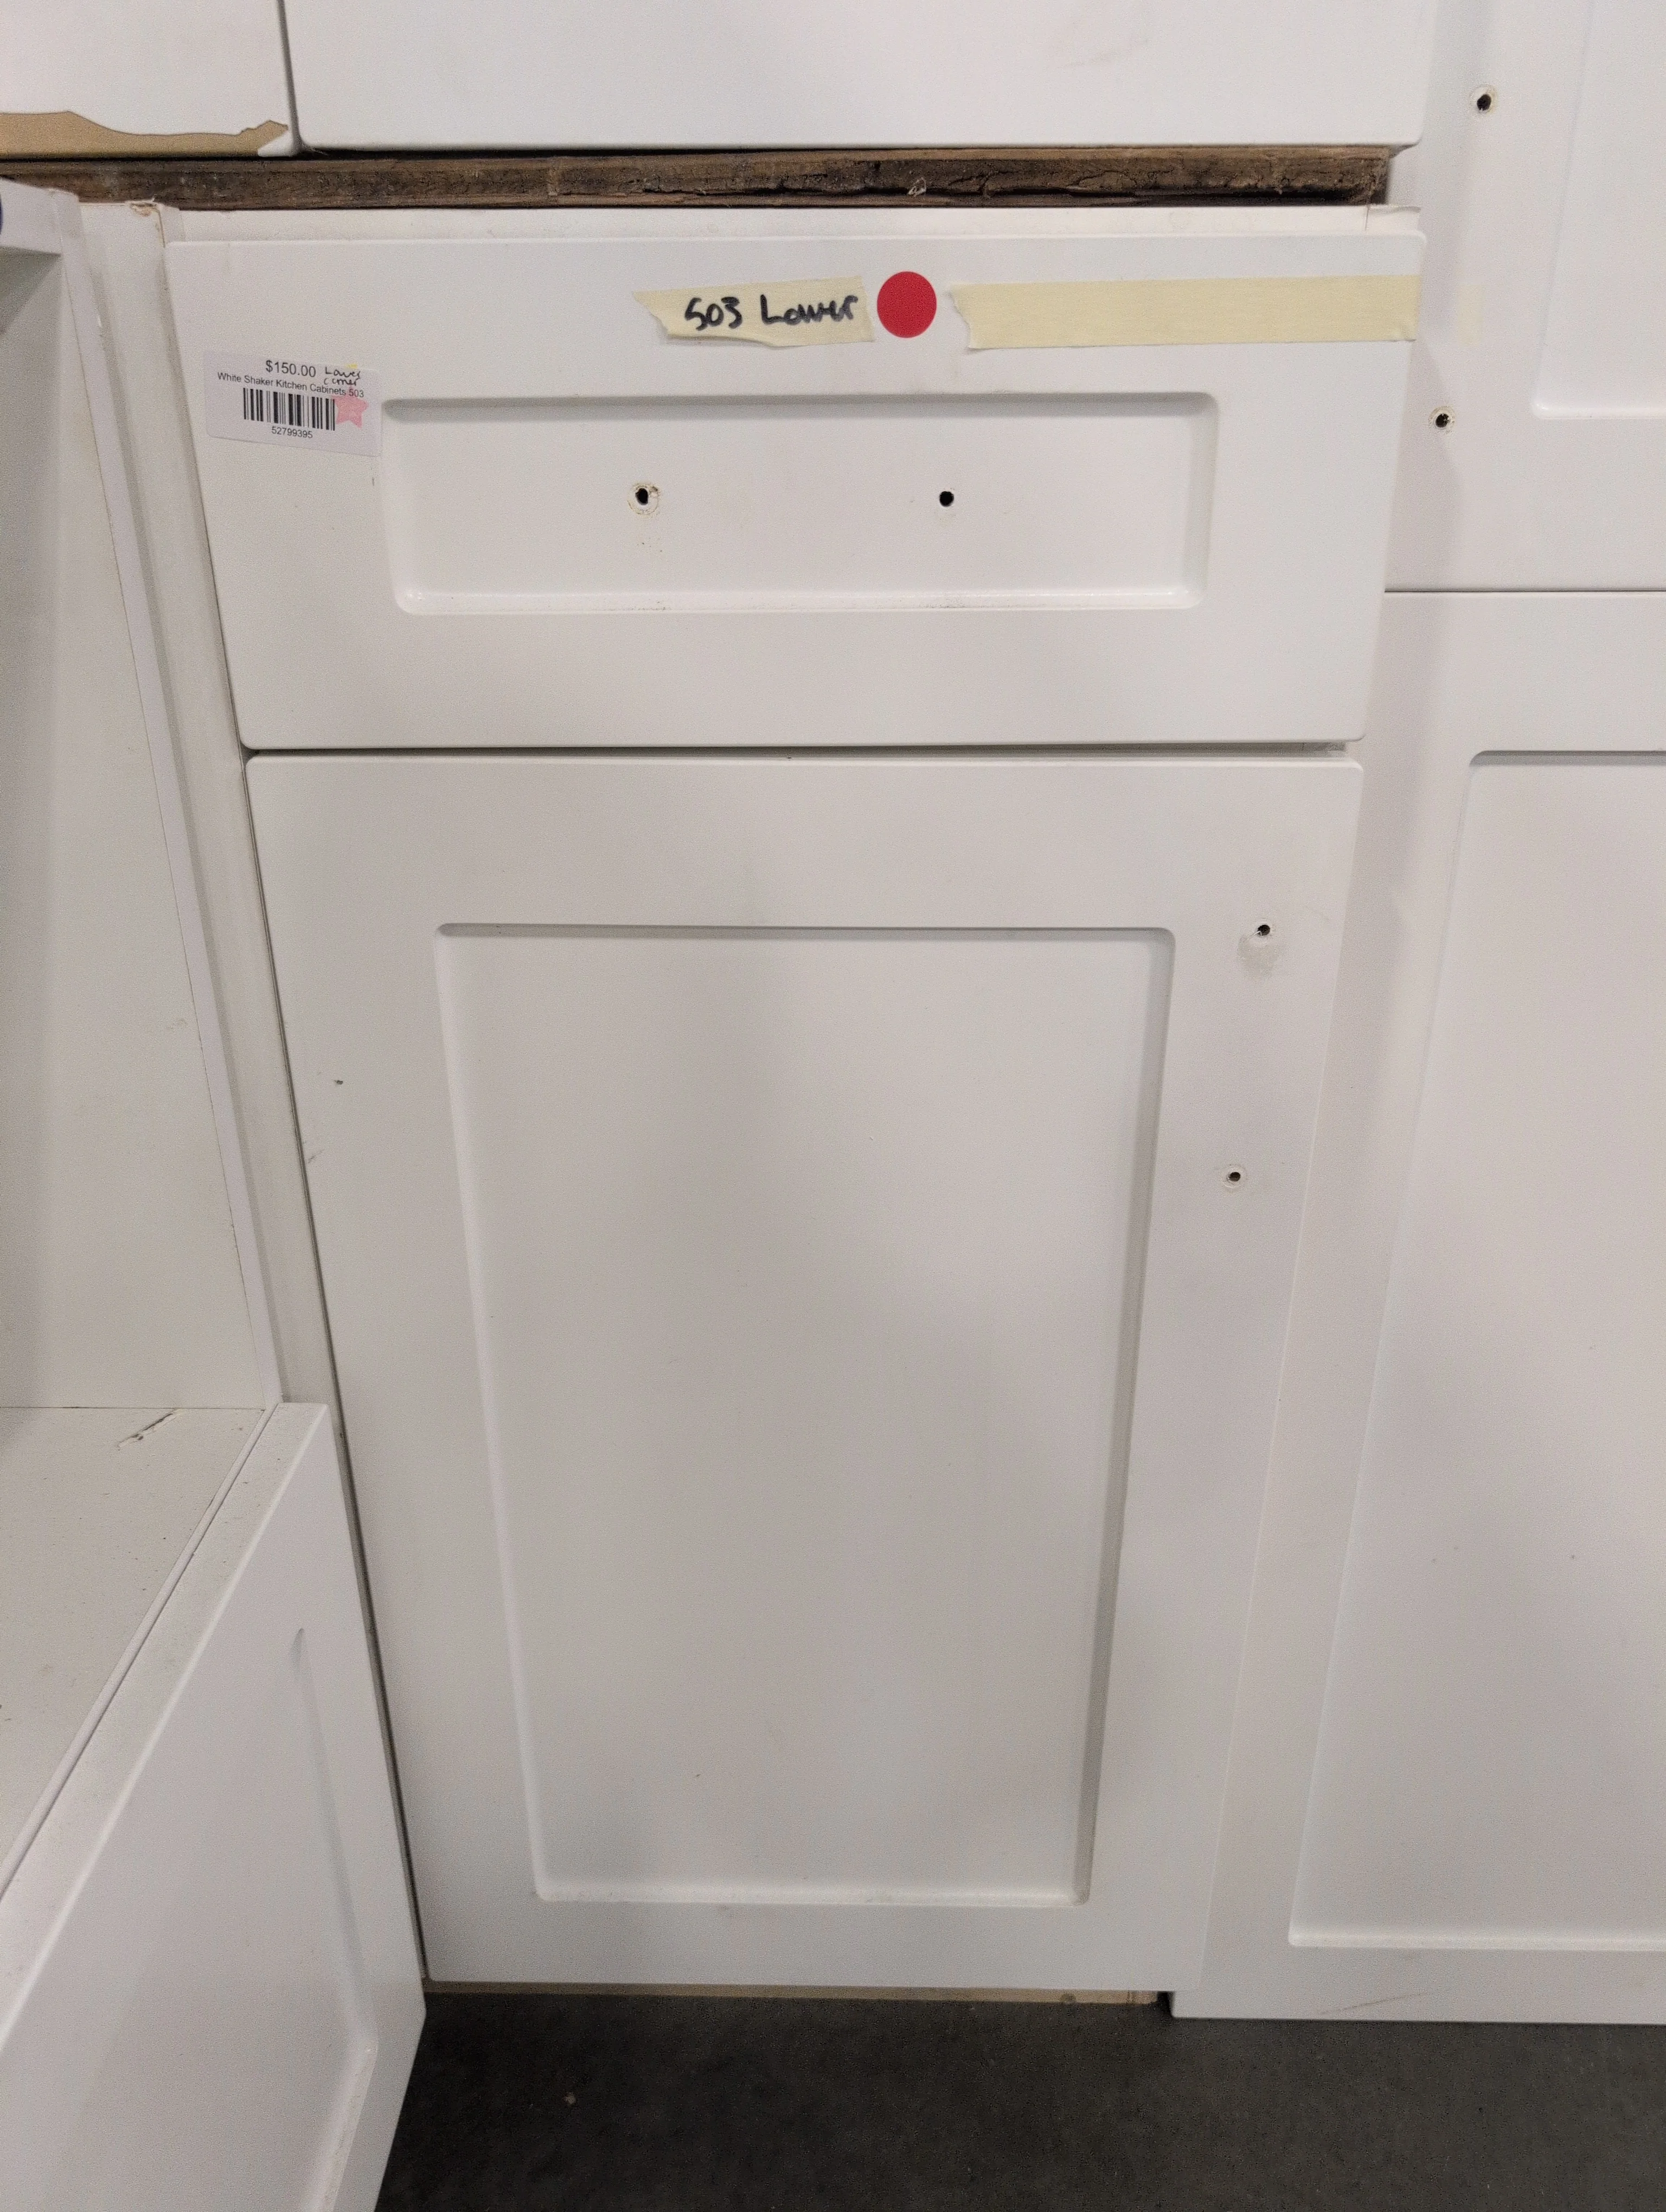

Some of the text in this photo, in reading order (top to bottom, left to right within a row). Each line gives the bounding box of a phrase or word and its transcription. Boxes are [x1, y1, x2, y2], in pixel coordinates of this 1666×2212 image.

[760, 294, 858, 325] Lower
[265, 360, 316, 377] $150.00
[217, 372, 364, 398] White Shaker Kitchen Cabinets 503
[271, 426, 313, 439] 52799395
